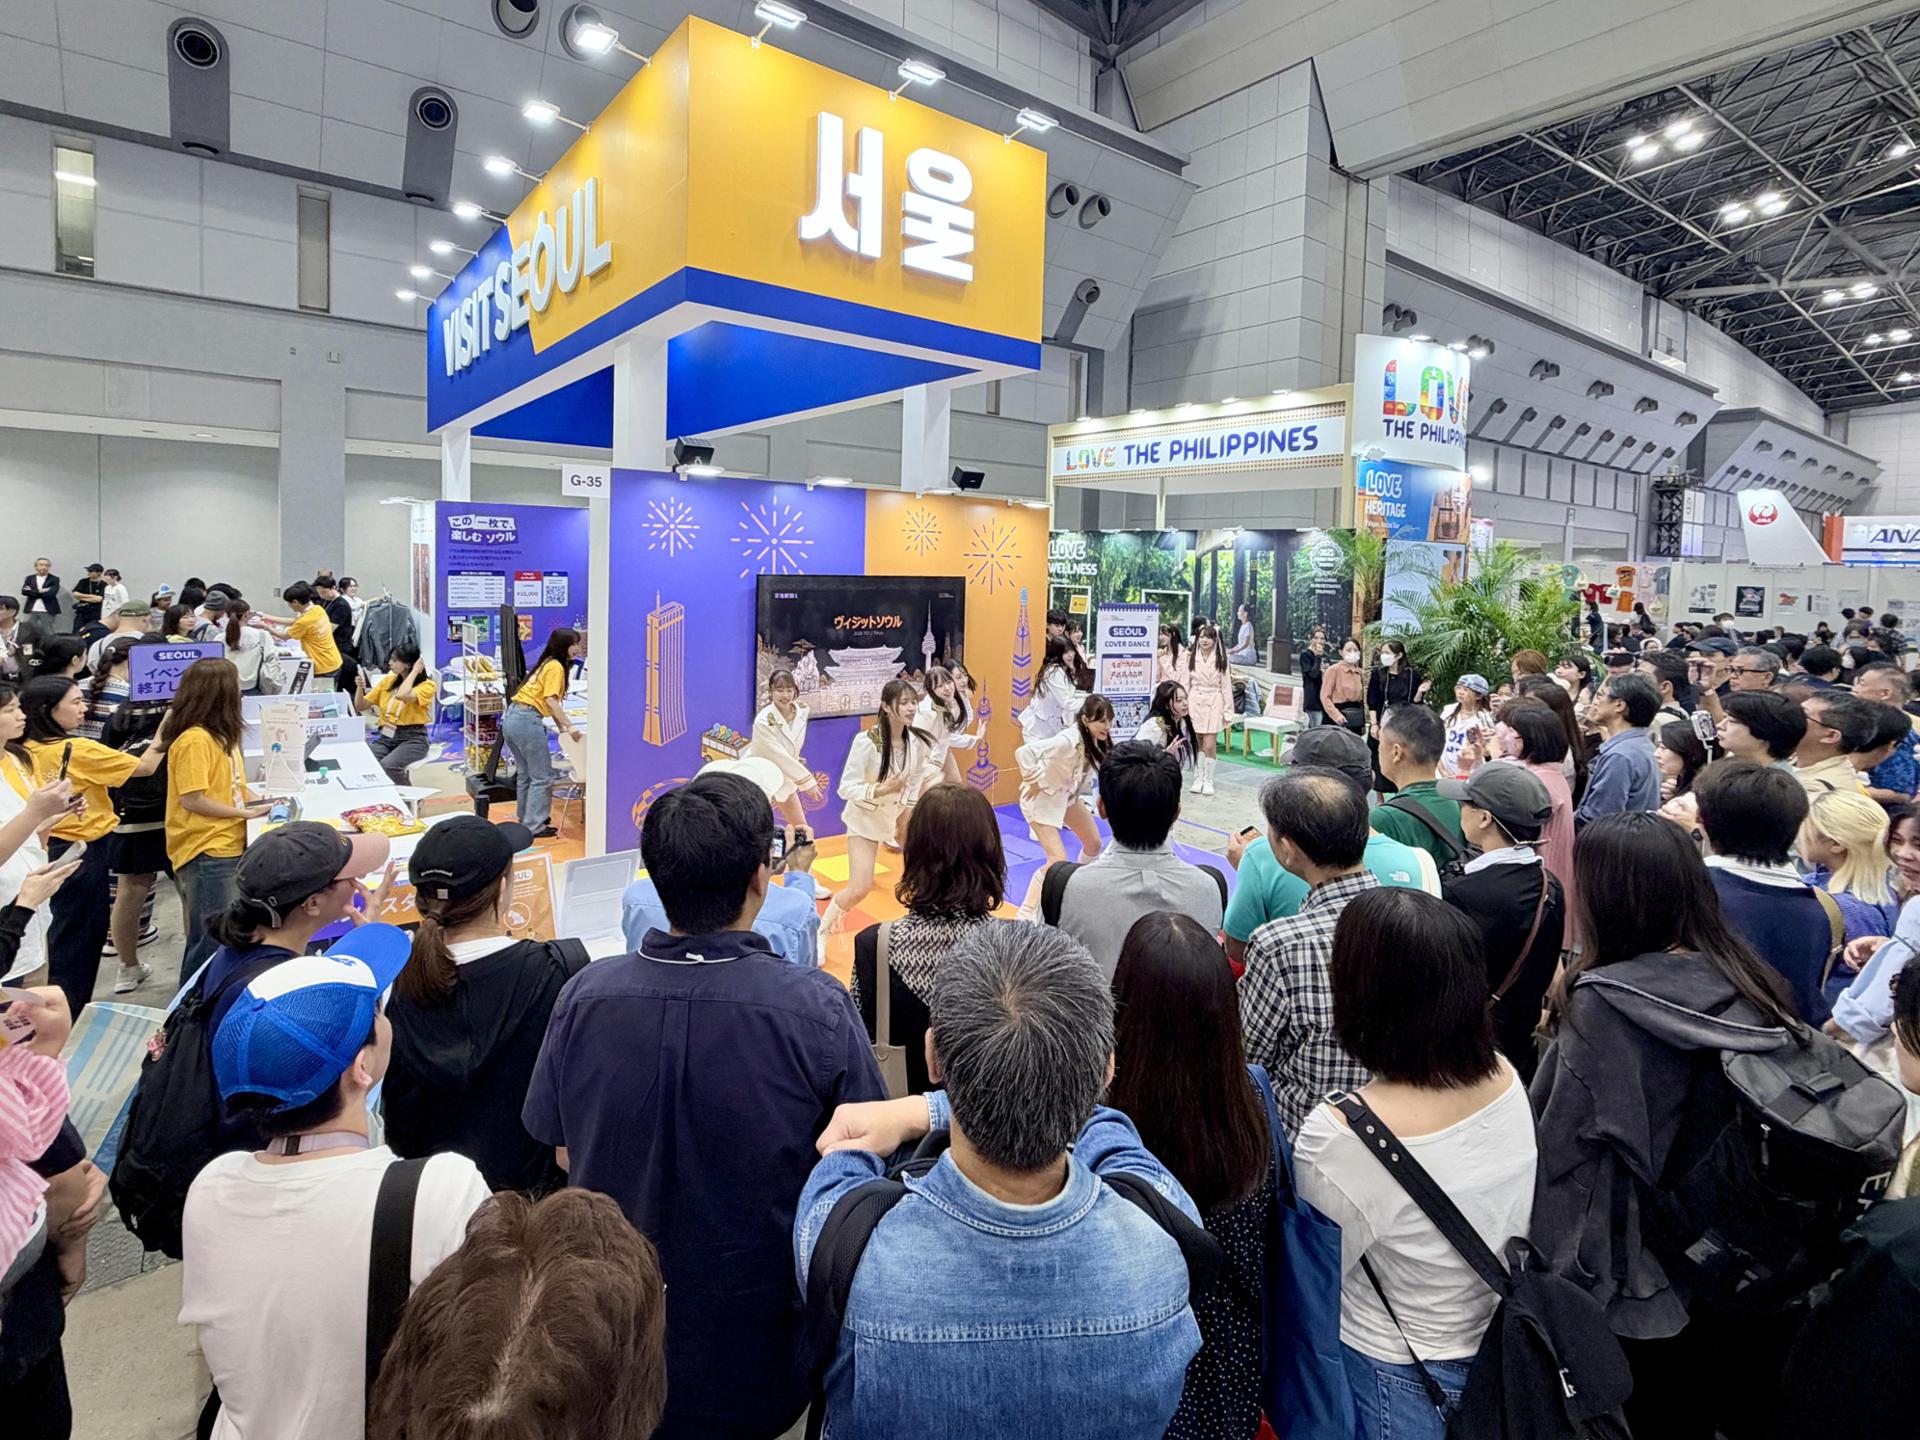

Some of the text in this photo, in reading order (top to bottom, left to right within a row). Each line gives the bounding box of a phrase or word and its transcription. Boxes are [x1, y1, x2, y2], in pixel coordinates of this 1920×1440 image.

[799, 111, 975, 282] 서울
[443, 177, 612, 377] VISIT SEOUL
[1382, 418, 1416, 440] THE
[1065, 425, 1319, 471] LOVE THE PHILIPPINES
[570, 474, 602, 488] G-35
[1366, 469, 1402, 498] LOVE
[1366, 500, 1407, 518] HERITAGE
[452, 516, 473, 527] この
[451, 530, 516, 543] 楽しむ ソウル
[1048, 540, 1086, 560] LOVE
[1048, 562, 1098, 576] WELLNESS
[834, 615, 903, 630] ヴィジットソウル
[1112, 626, 1145, 636] SEOUL
[1104, 640, 1151, 648] COVER DANCE
[158, 650, 199, 660] SEOUL
